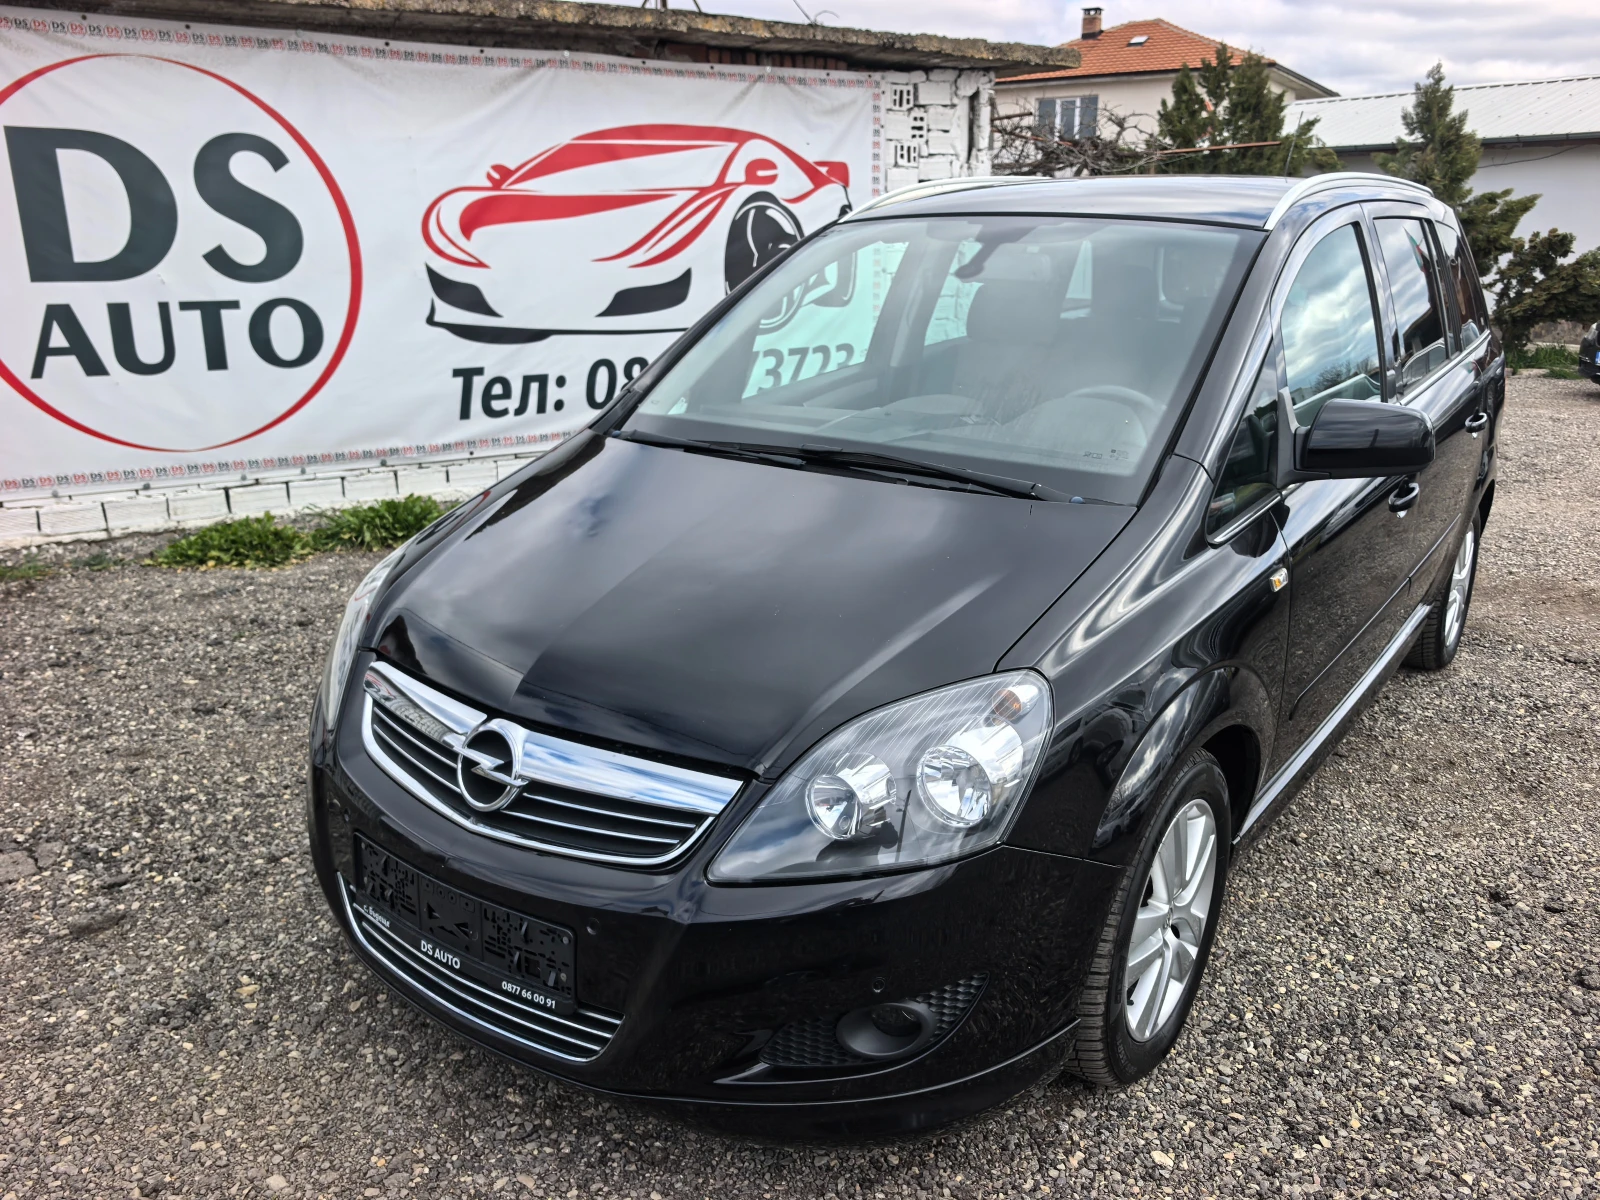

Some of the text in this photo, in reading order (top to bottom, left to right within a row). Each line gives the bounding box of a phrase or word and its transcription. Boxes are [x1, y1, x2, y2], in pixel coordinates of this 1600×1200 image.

[3, 125, 304, 283] DS
[30, 297, 325, 379] AUTO
[452, 343, 855, 421] Тел: 08 3723
[420, 940, 460, 970] DS AUTO
[502, 980, 556, 1009] 0877 66 00 91
